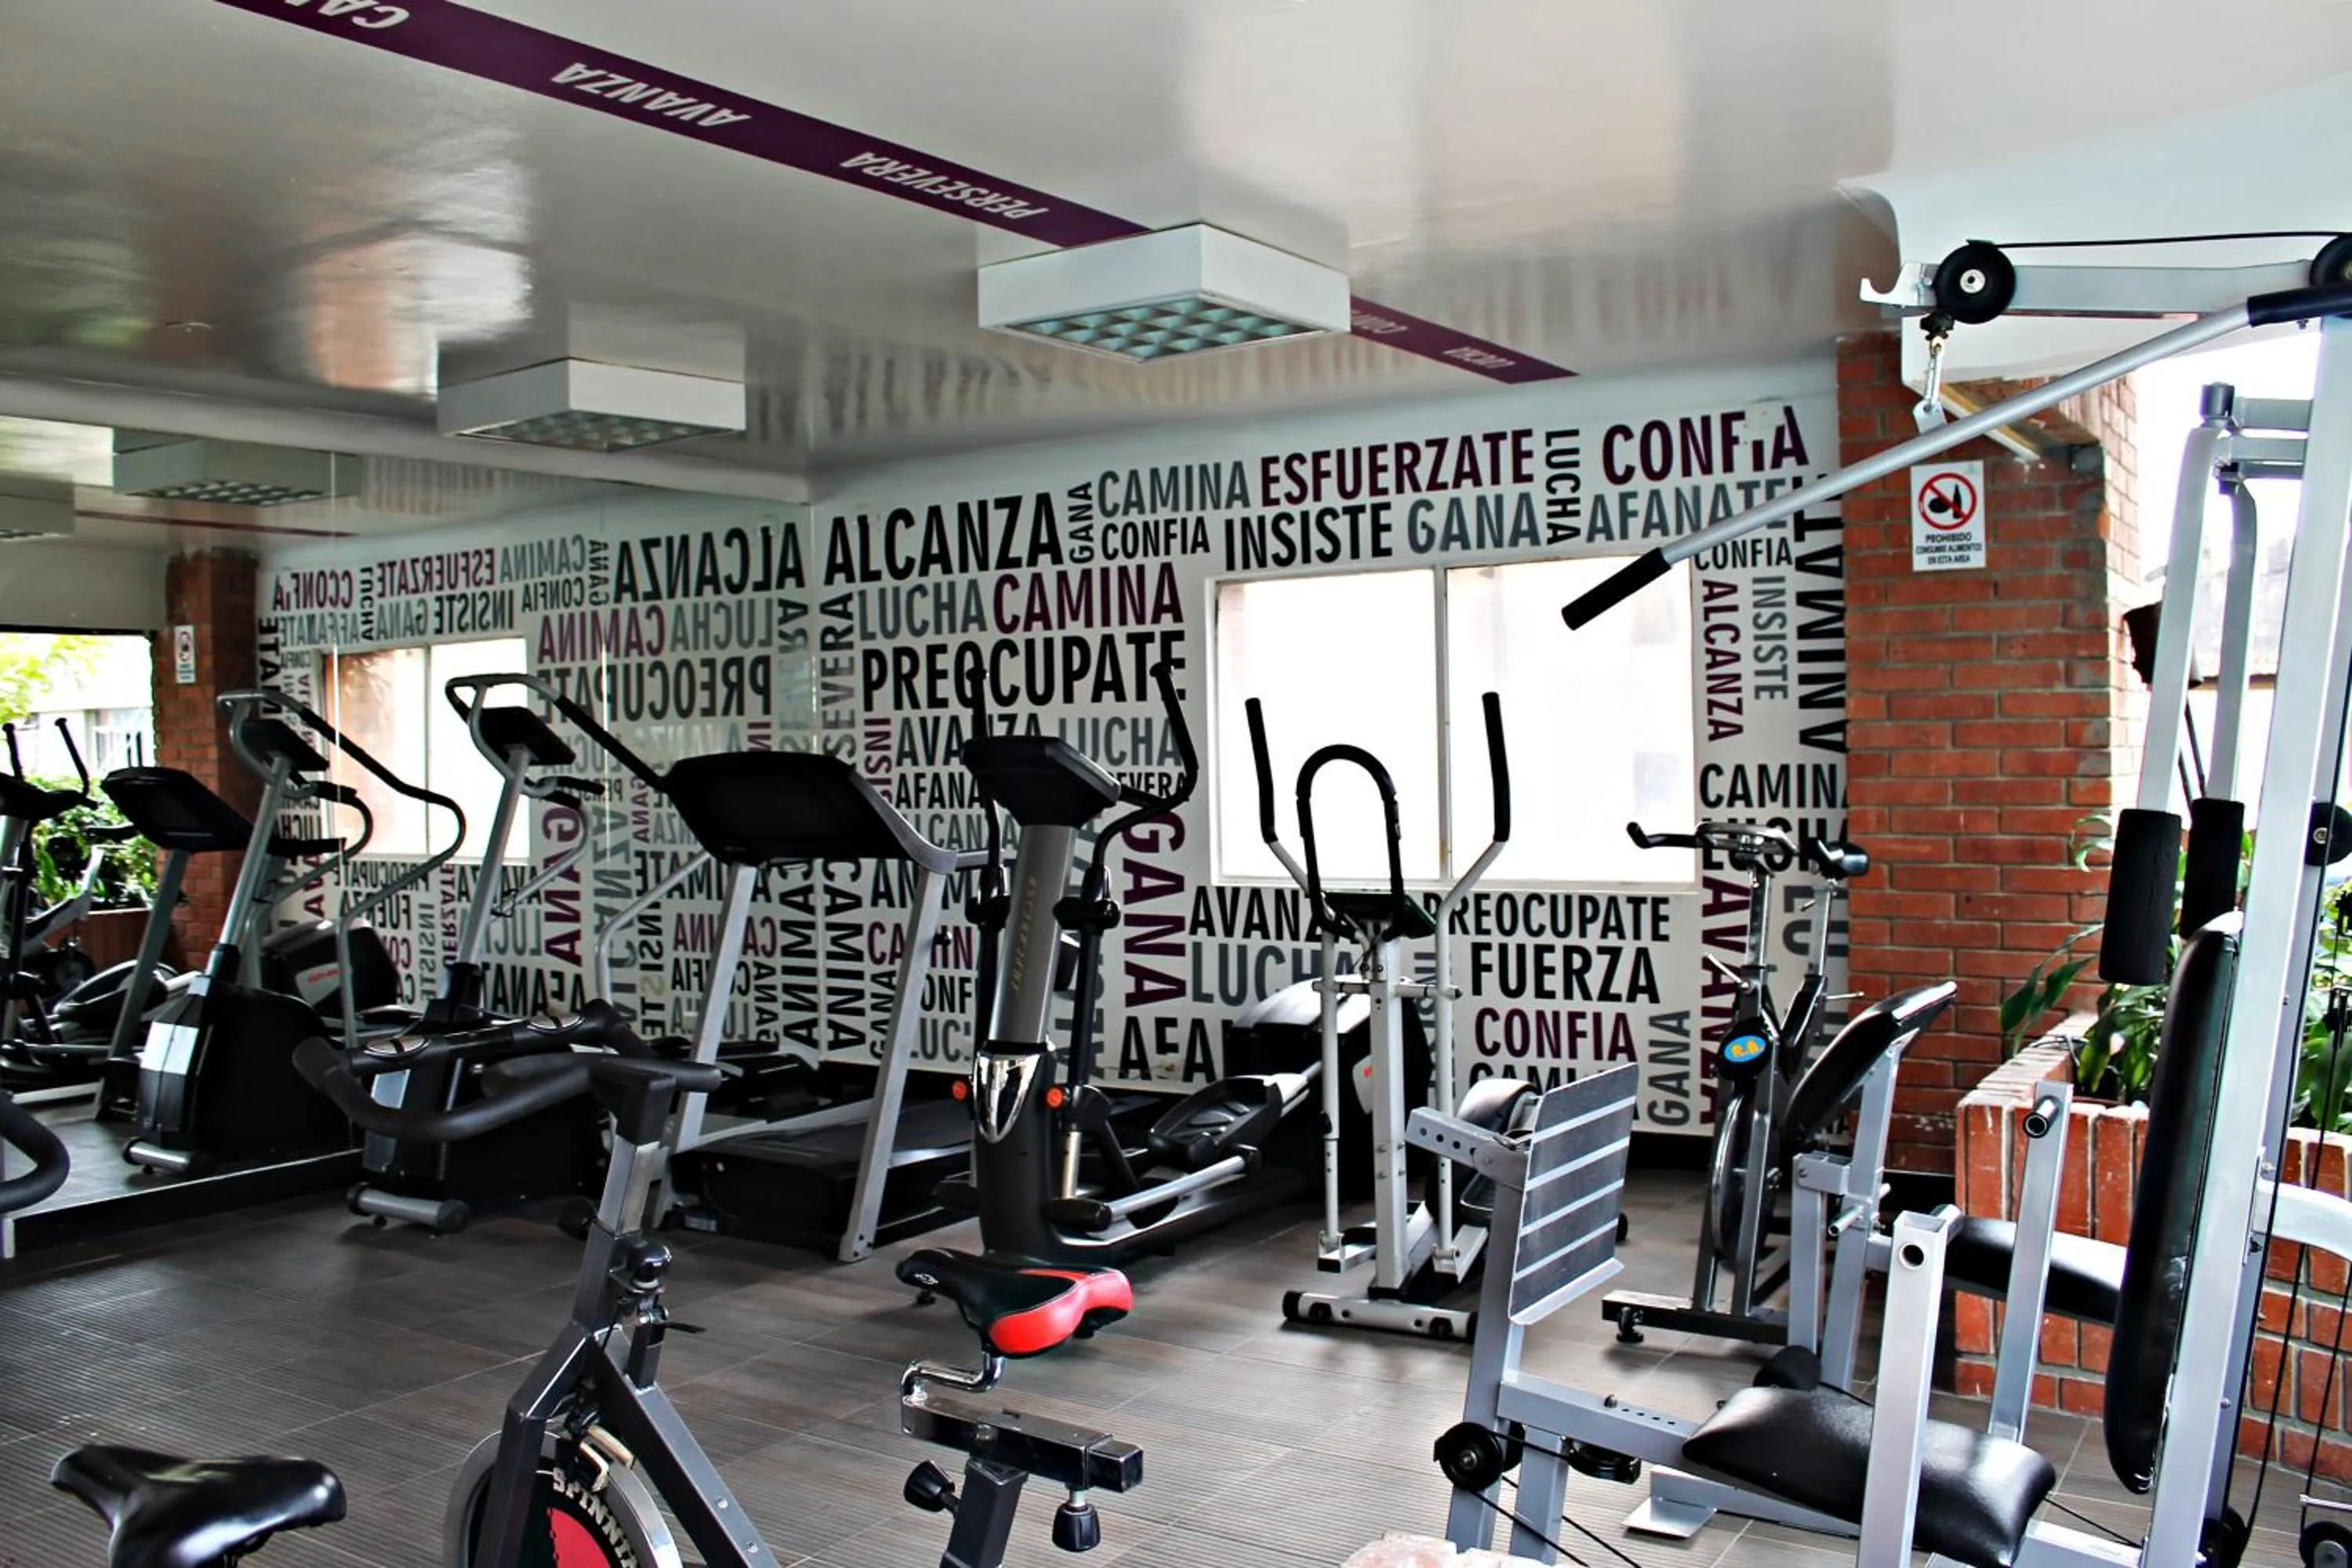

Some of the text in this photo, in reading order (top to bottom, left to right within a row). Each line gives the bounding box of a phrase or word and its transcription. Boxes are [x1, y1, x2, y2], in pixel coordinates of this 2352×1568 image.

[551, 62, 752, 127] AVANZA
[840, 151, 1049, 222] PERSEVERA
[1098, 460, 1250, 517] CAMINA
[1261, 428, 1534, 507] ESFUERZATE
[1545, 429, 1581, 546] LUCHA
[823, 492, 1064, 586] ALCANZA
[1067, 481, 1094, 564] GANA
[1102, 516, 1211, 561] CONFIA
[1225, 502, 1392, 572] INSISTE
[1408, 492, 1541, 554] GANA
[1694, 537, 1793, 571] CONFIA
[858, 578, 988, 641] LUCHA
[993, 562, 1183, 634] CAMINA
[862, 630, 1186, 712] PREOCUPATE
[1702, 579, 1744, 742] ALCANZA
[1752, 576, 1788, 700] INSISTE
[820, 592, 857, 760] SEVERA
[1700, 763, 1849, 808] CAMIN
[1122, 811, 1187, 1008] GANA
[1471, 942, 1661, 1004] FUERZA
[1475, 1007, 1638, 1062] CONFIA
[1648, 1010, 1691, 1127] GANA
